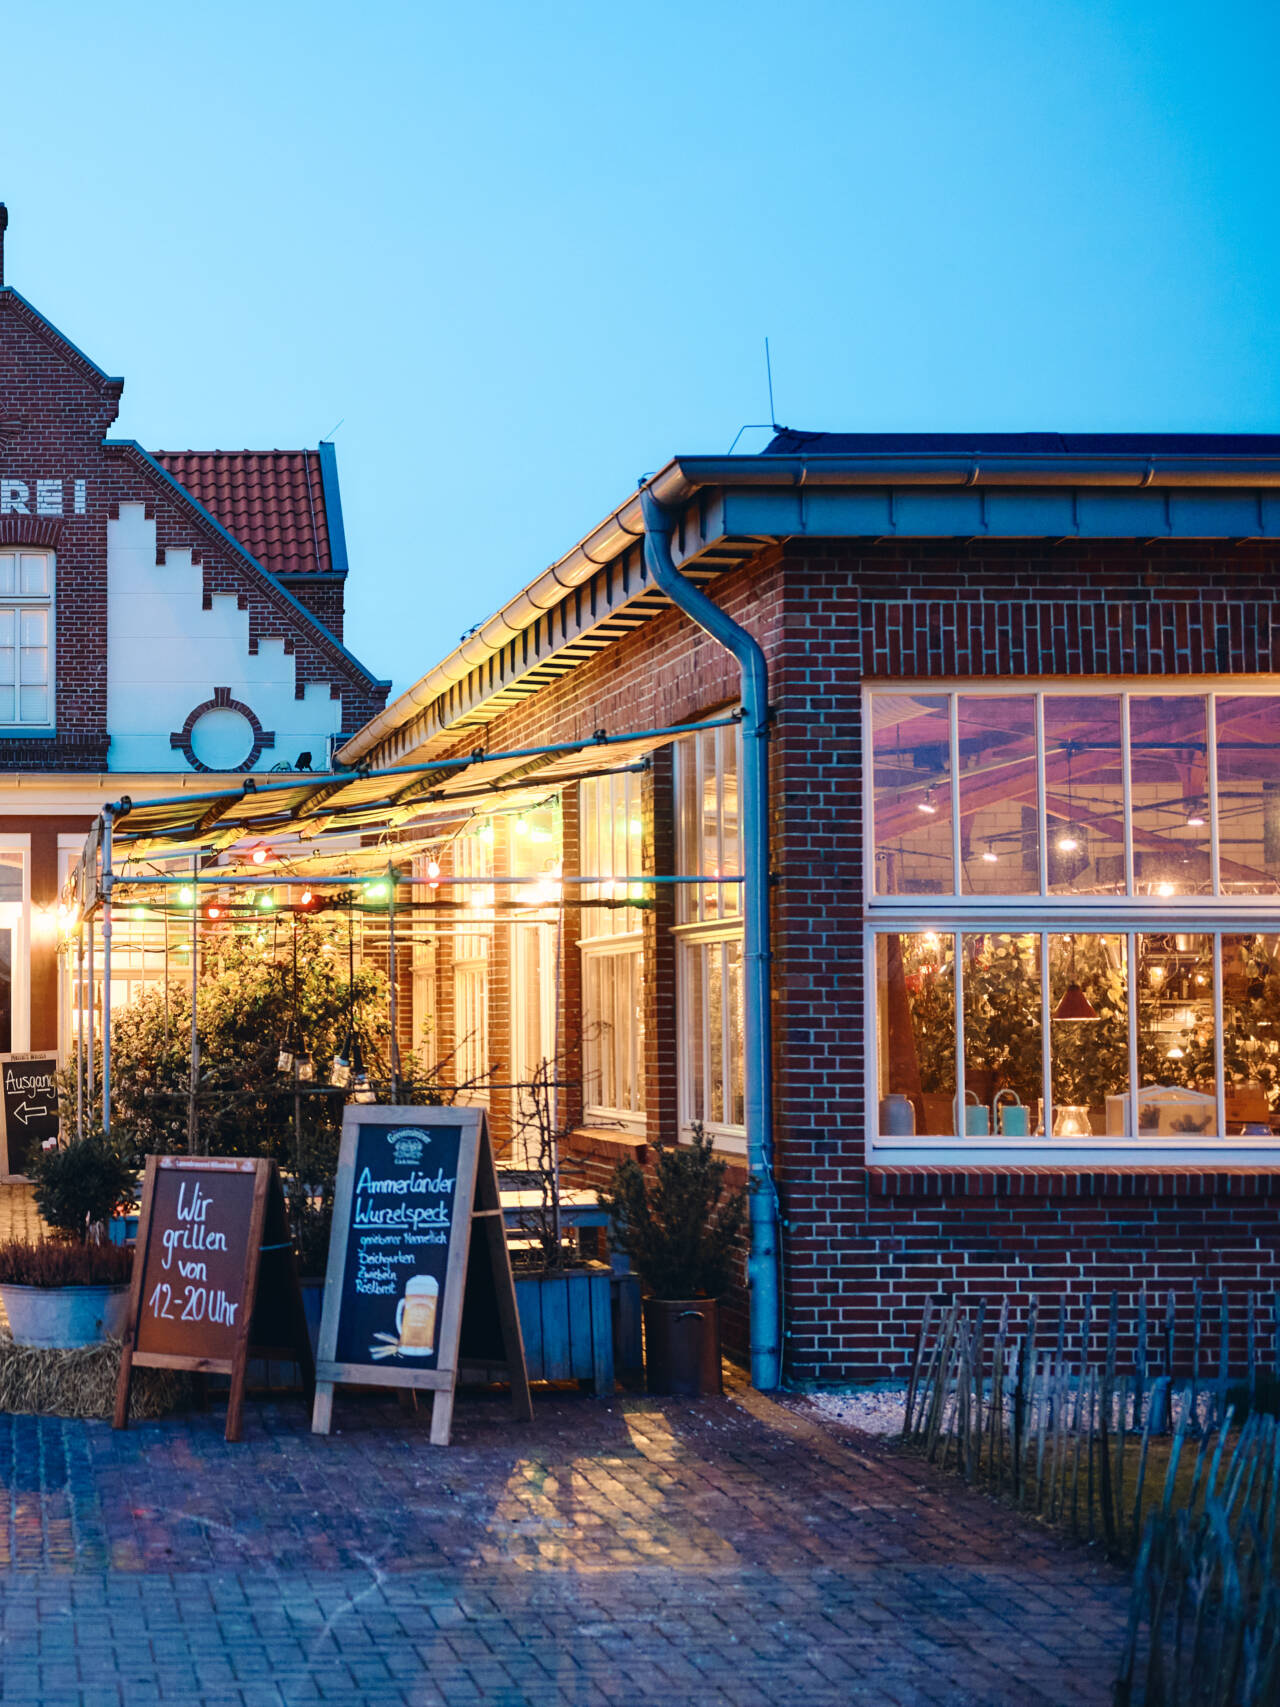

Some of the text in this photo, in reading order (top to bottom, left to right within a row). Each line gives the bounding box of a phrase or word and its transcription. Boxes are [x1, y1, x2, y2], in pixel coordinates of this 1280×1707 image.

[5, 1069, 56, 1099] Ausgang
[356, 1167, 456, 1194] Ammerländer
[177, 1181, 214, 1222] Wir
[355, 1197, 449, 1232] Wurzelspeck
[161, 1224, 228, 1270] grillen
[178, 1260, 207, 1281] von
[149, 1283, 239, 1327] 12-20 Uhr
